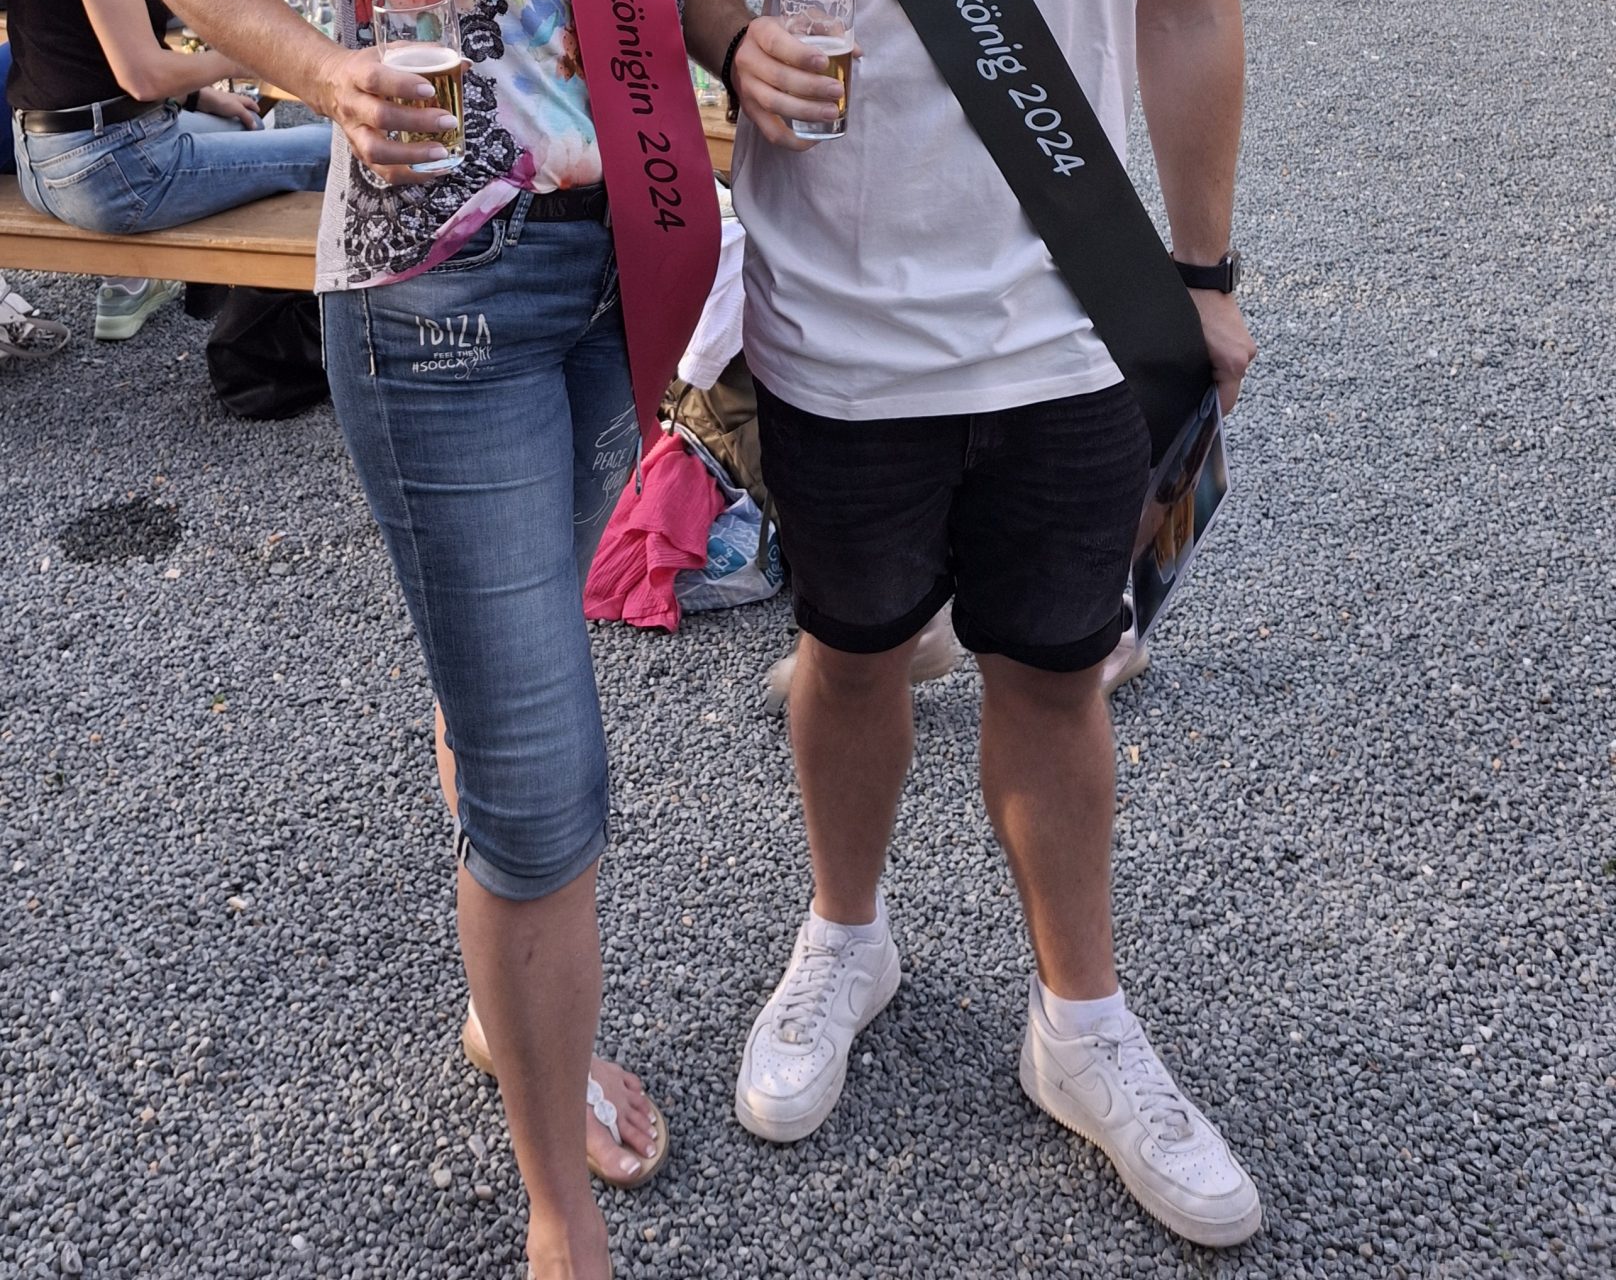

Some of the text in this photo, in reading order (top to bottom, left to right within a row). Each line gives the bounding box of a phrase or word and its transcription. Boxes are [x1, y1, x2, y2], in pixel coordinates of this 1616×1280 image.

[1008, 83, 1086, 177] 2024
[636, 129, 687, 233] 2024
[415, 313, 492, 348] IBIZA
[411, 358, 465, 374] #SOCCX
[433, 345, 492, 361] FEEL THE SKY
[592, 447, 628, 470] PEACE
